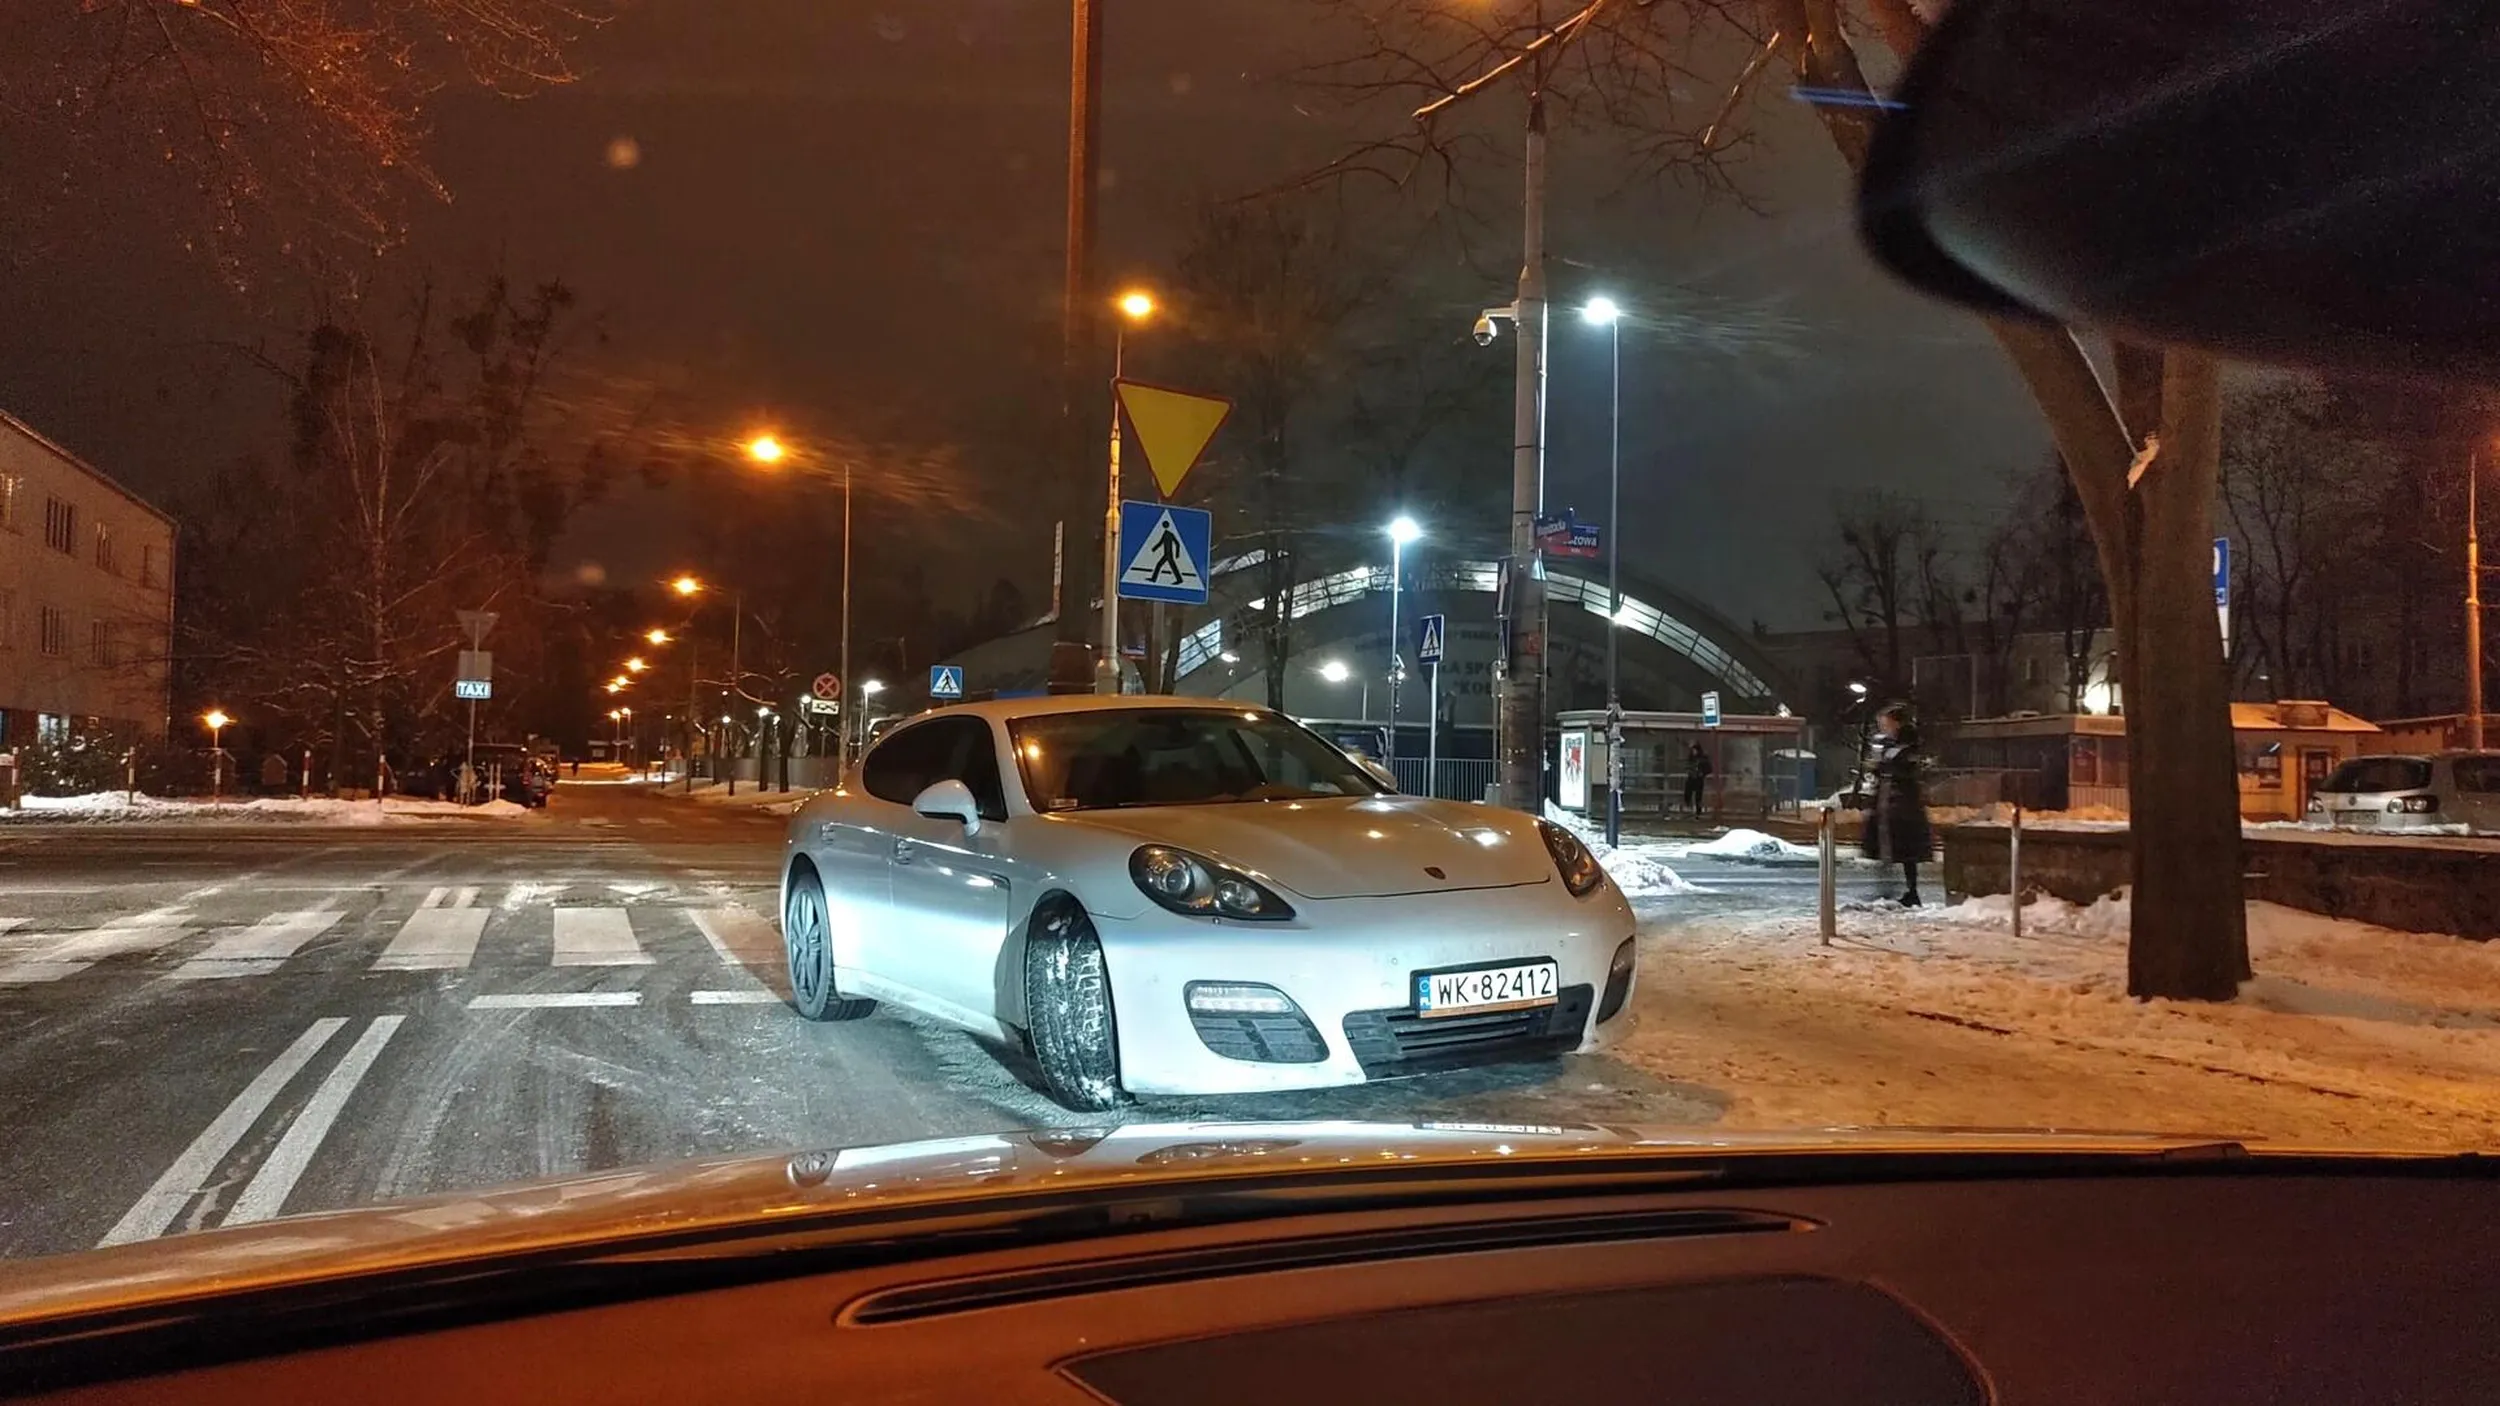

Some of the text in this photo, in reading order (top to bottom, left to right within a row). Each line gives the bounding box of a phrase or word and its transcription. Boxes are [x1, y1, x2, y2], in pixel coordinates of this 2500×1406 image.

[457, 683, 488, 696] TAXI
[1438, 967, 1552, 1005] WK 82412
